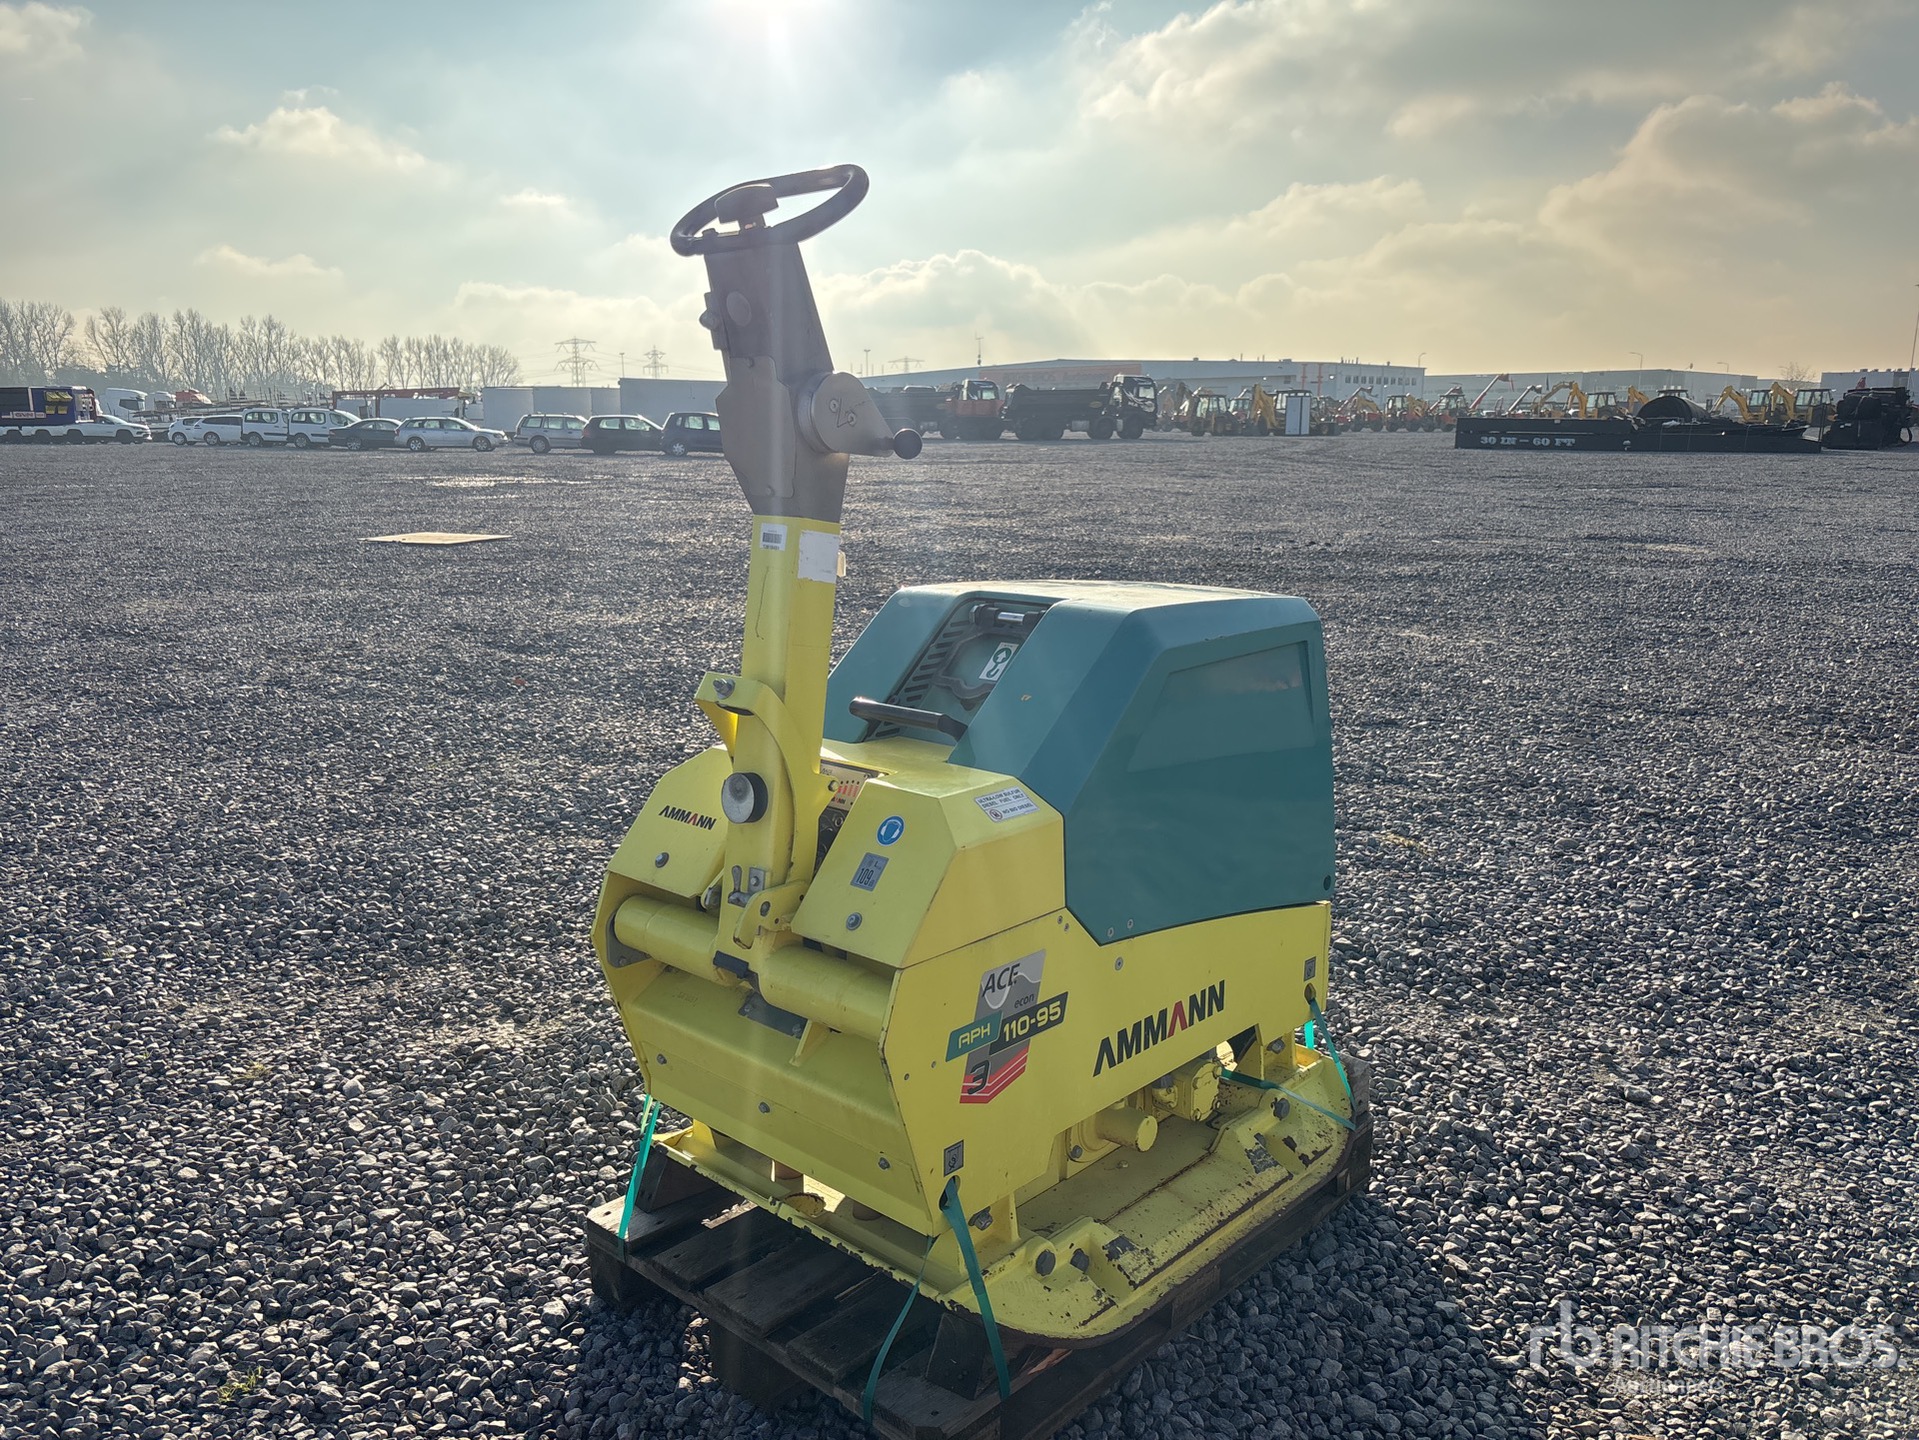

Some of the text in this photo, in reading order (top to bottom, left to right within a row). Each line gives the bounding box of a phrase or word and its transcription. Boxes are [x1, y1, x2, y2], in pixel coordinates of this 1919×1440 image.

[1480, 436, 1497, 445] 30
[1500, 436, 1517, 445] IN
[1532, 437, 1551, 446] 60
[1554, 438, 1576, 447] FT
[981, 800, 998, 809] DIESEL
[1017, 802, 1034, 811] DIESEL
[658, 805, 717, 831] AMMANN
[855, 868, 875, 886] 109
[982, 963, 1021, 997] ACE
[1013, 993, 1035, 1009] econ
[958, 1000, 1062, 1049] APH 110-95
[1093, 979, 1225, 1078] AMMANN
